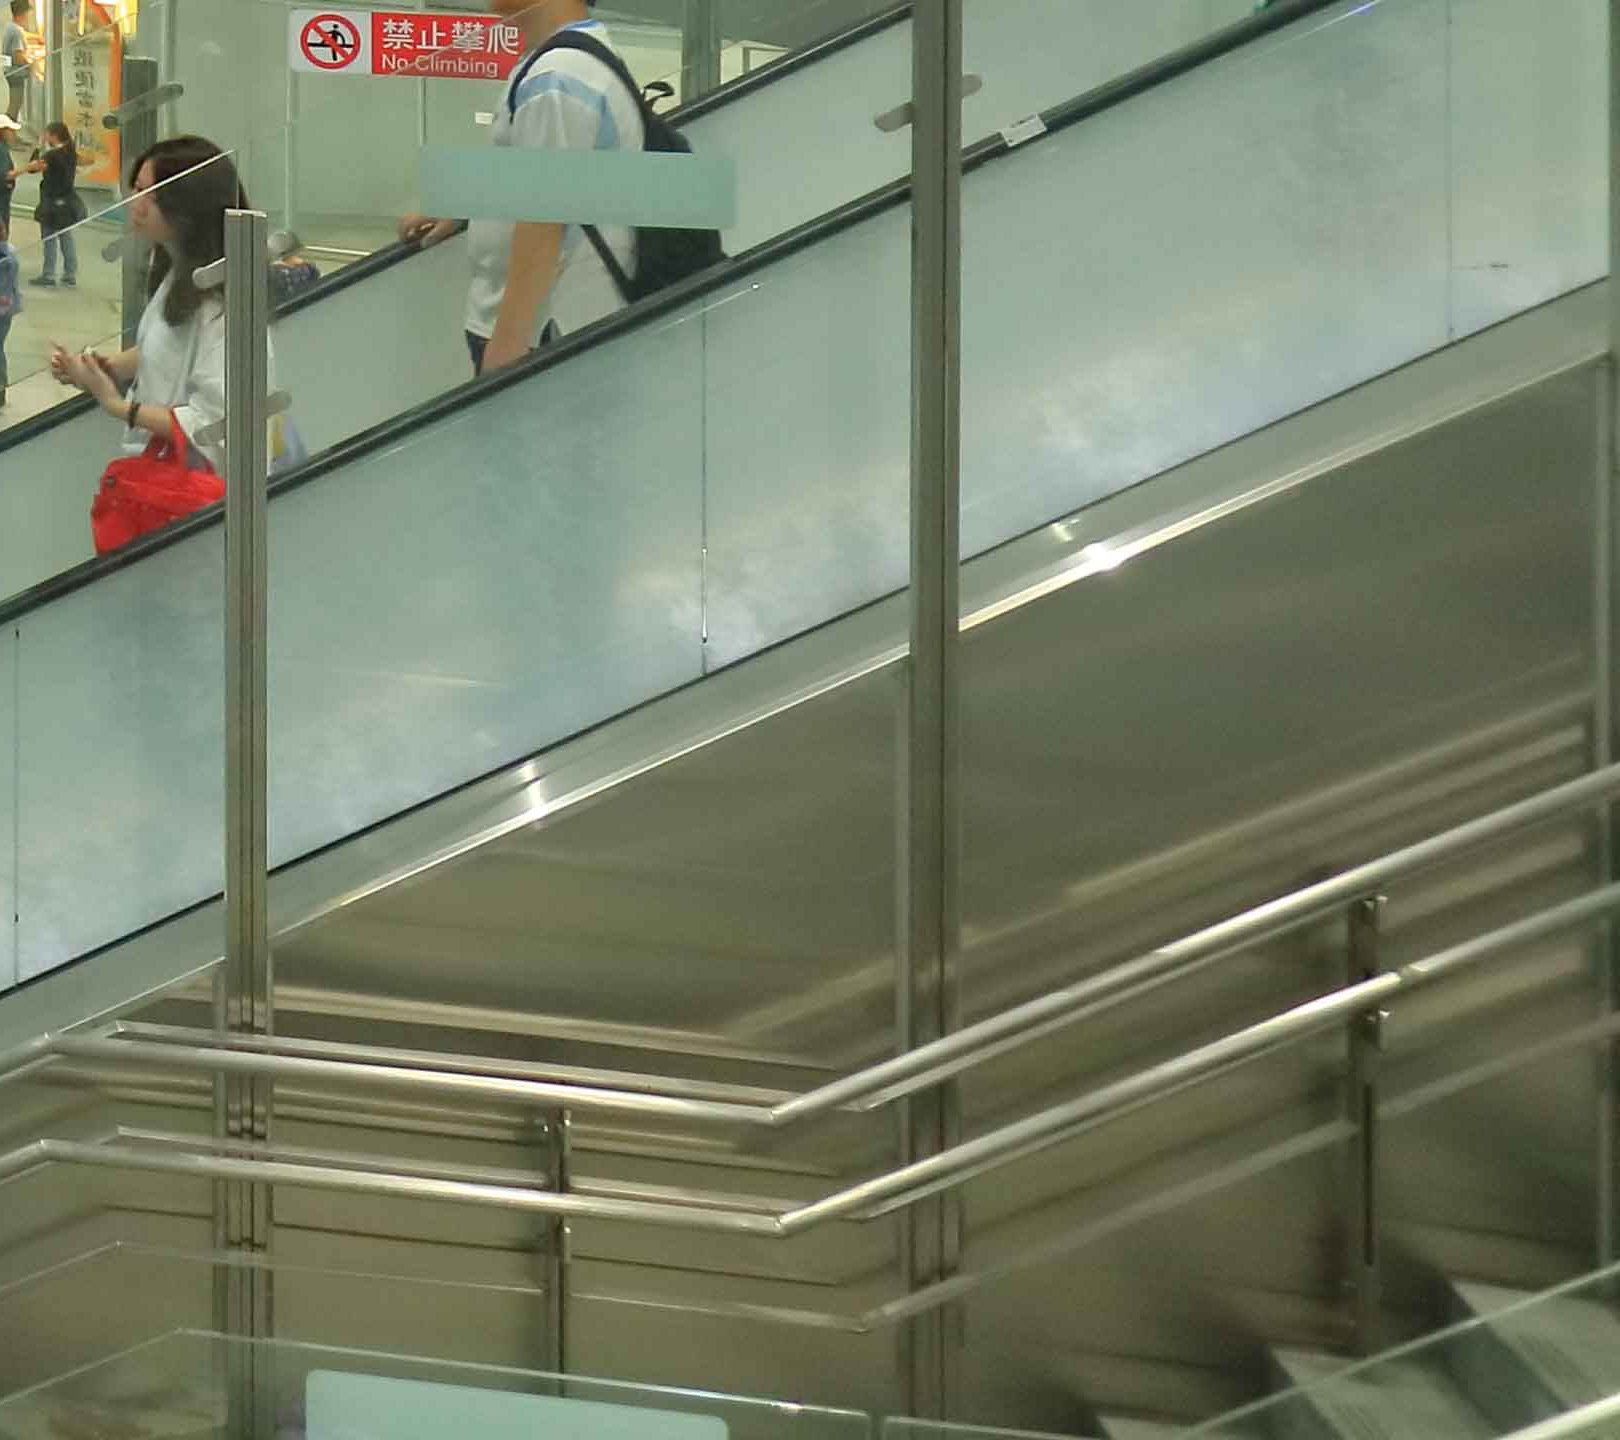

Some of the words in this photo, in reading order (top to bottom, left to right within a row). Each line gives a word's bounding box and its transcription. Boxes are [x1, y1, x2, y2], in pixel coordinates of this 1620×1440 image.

[382, 19, 520, 55] 禁止攀爬
[381, 53, 408, 70] No
[415, 55, 498, 78] Climbing
